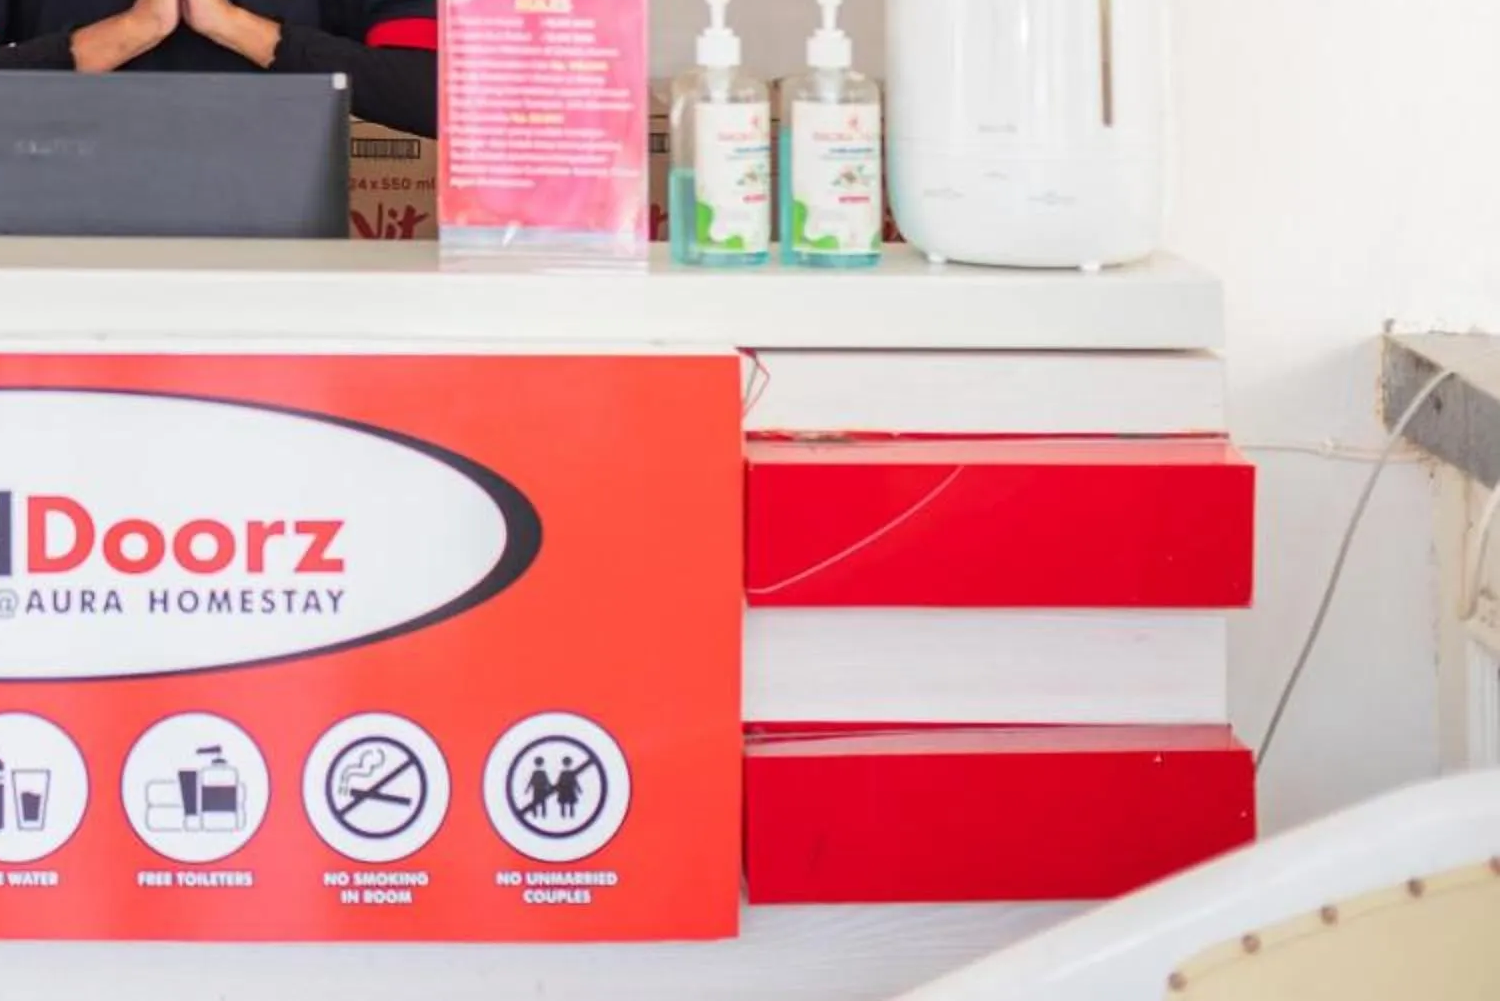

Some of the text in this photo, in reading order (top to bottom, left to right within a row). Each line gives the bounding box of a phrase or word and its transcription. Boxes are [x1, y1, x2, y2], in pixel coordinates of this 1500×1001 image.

[148, 589, 345, 615] HOMESTAY
[7, 871, 59, 886] WATER
[137, 871, 172, 887] FREE
[323, 872, 429, 887] NO SMOKING
[496, 872, 618, 886] NO UNMARRIED
[340, 888, 412, 904] IN ROOM
[522, 888, 592, 904] COUPLES
